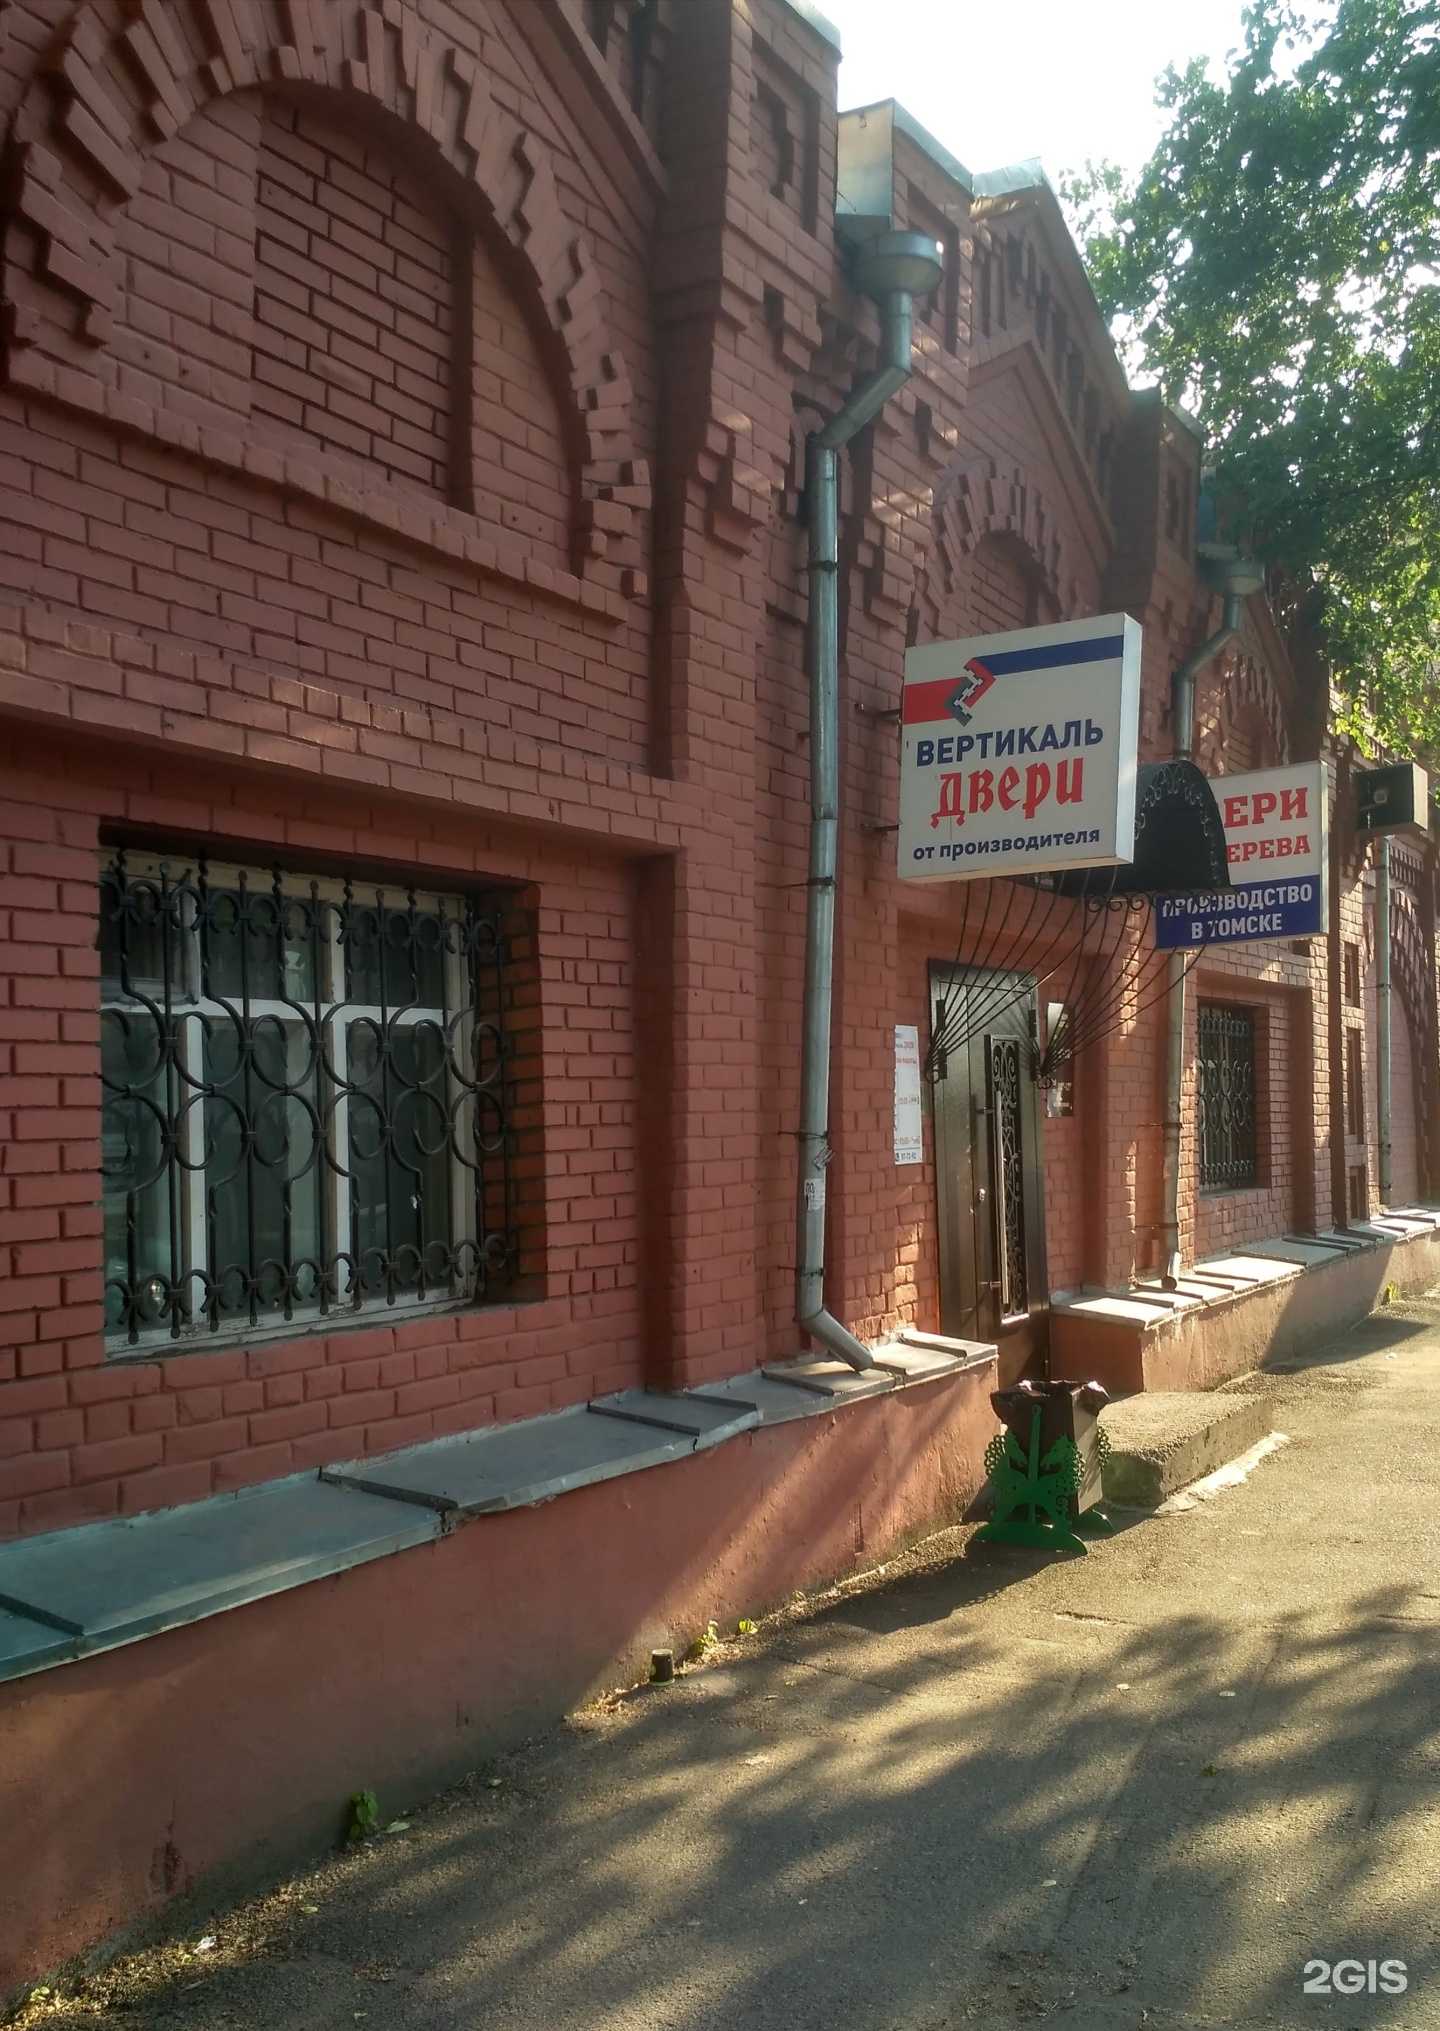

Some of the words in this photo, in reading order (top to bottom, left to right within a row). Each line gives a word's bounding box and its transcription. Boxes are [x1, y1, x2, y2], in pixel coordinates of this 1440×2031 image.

[916, 719, 1104, 767] ВЕРТИКАЛЬ
[1221, 787, 1308, 829] ЕРИ
[913, 843, 935, 861] от
[939, 829, 1100, 861] производителя
[1226, 834, 1311, 864] ЕРЕВА
[1191, 921, 1203, 940] В
[1208, 913, 1282, 937] ТОМСКЕ
